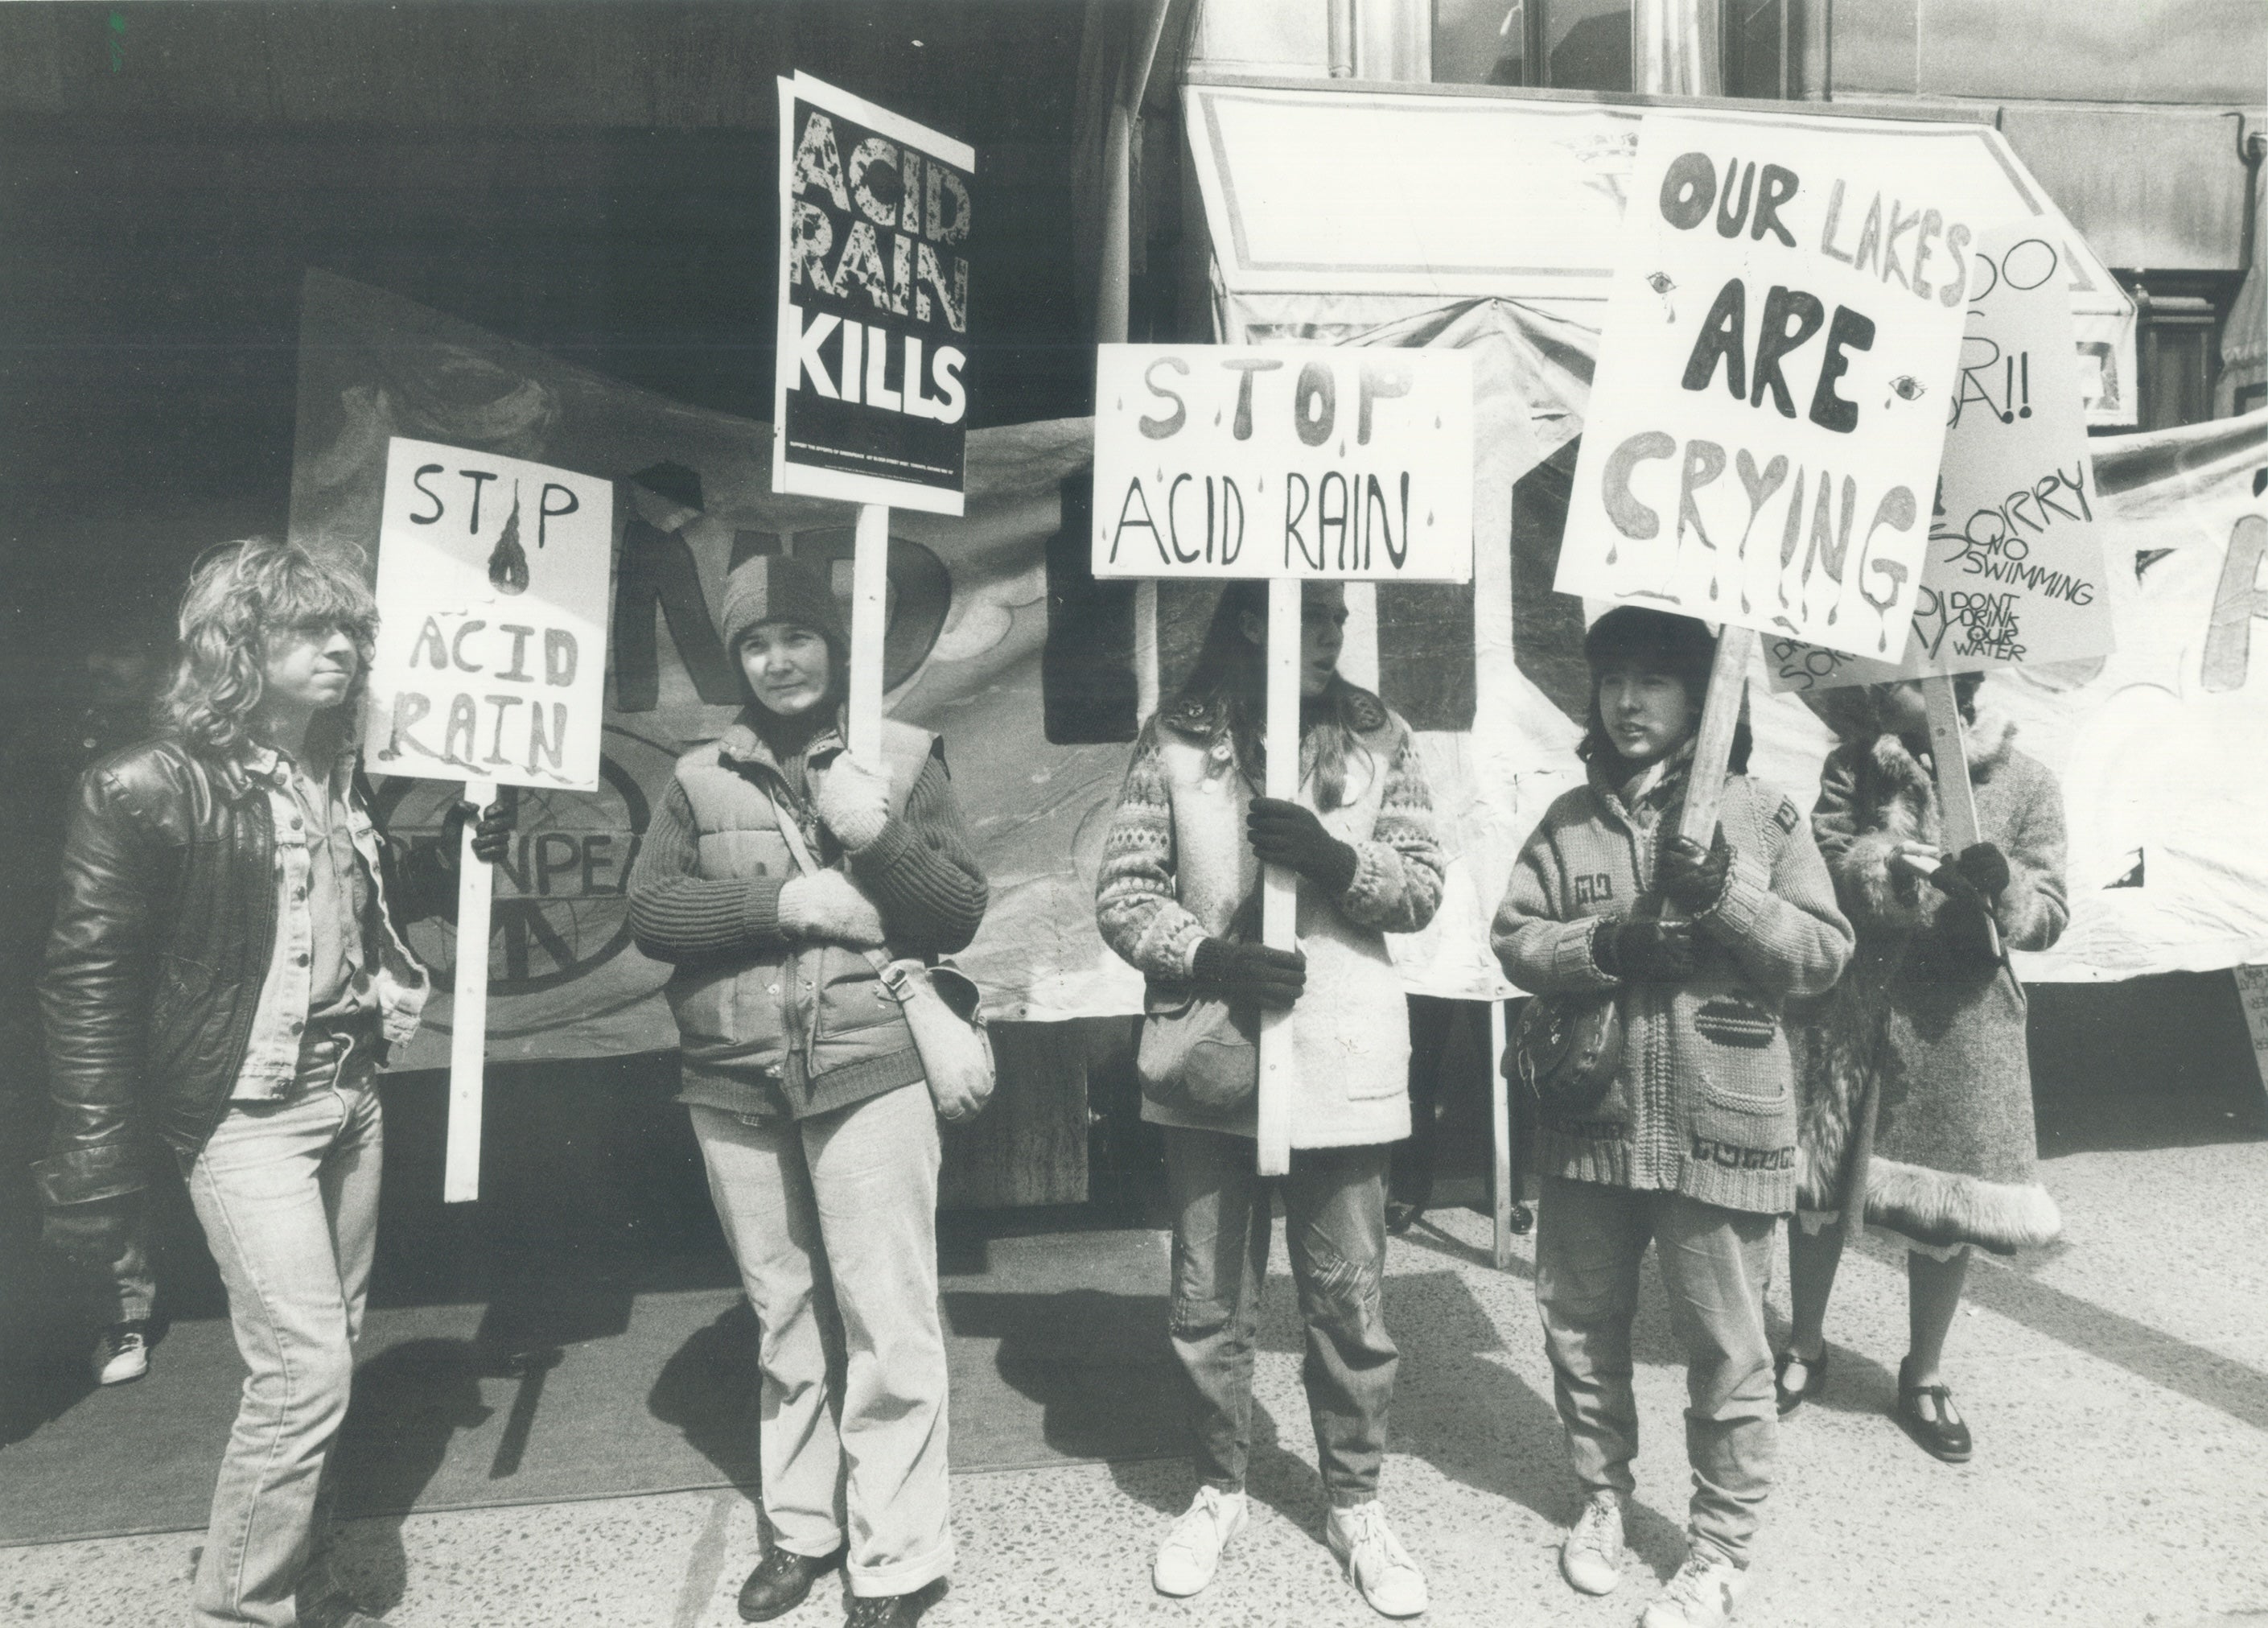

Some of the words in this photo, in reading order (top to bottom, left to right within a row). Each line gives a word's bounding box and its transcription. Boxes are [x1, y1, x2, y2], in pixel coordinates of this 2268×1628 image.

[790, 110, 970, 241] ACID
[789, 199, 969, 333] RAIN
[1659, 151, 1800, 248] OUR
[1821, 179, 1972, 308] LAKES
[786, 303, 965, 425] KILLS
[1138, 356, 1414, 447] STOP
[1681, 278, 1876, 435] ARE
[1108, 472, 1245, 565] ACID
[1286, 470, 1410, 571] RAIN
[1601, 431, 1918, 610] CRYING
[1987, 534, 2029, 561] NO
[1962, 550, 2094, 606] SWIMMING
[409, 615, 578, 688] ACID
[1953, 640, 2027, 662] WATER
[377, 690, 568, 776] RAIN
